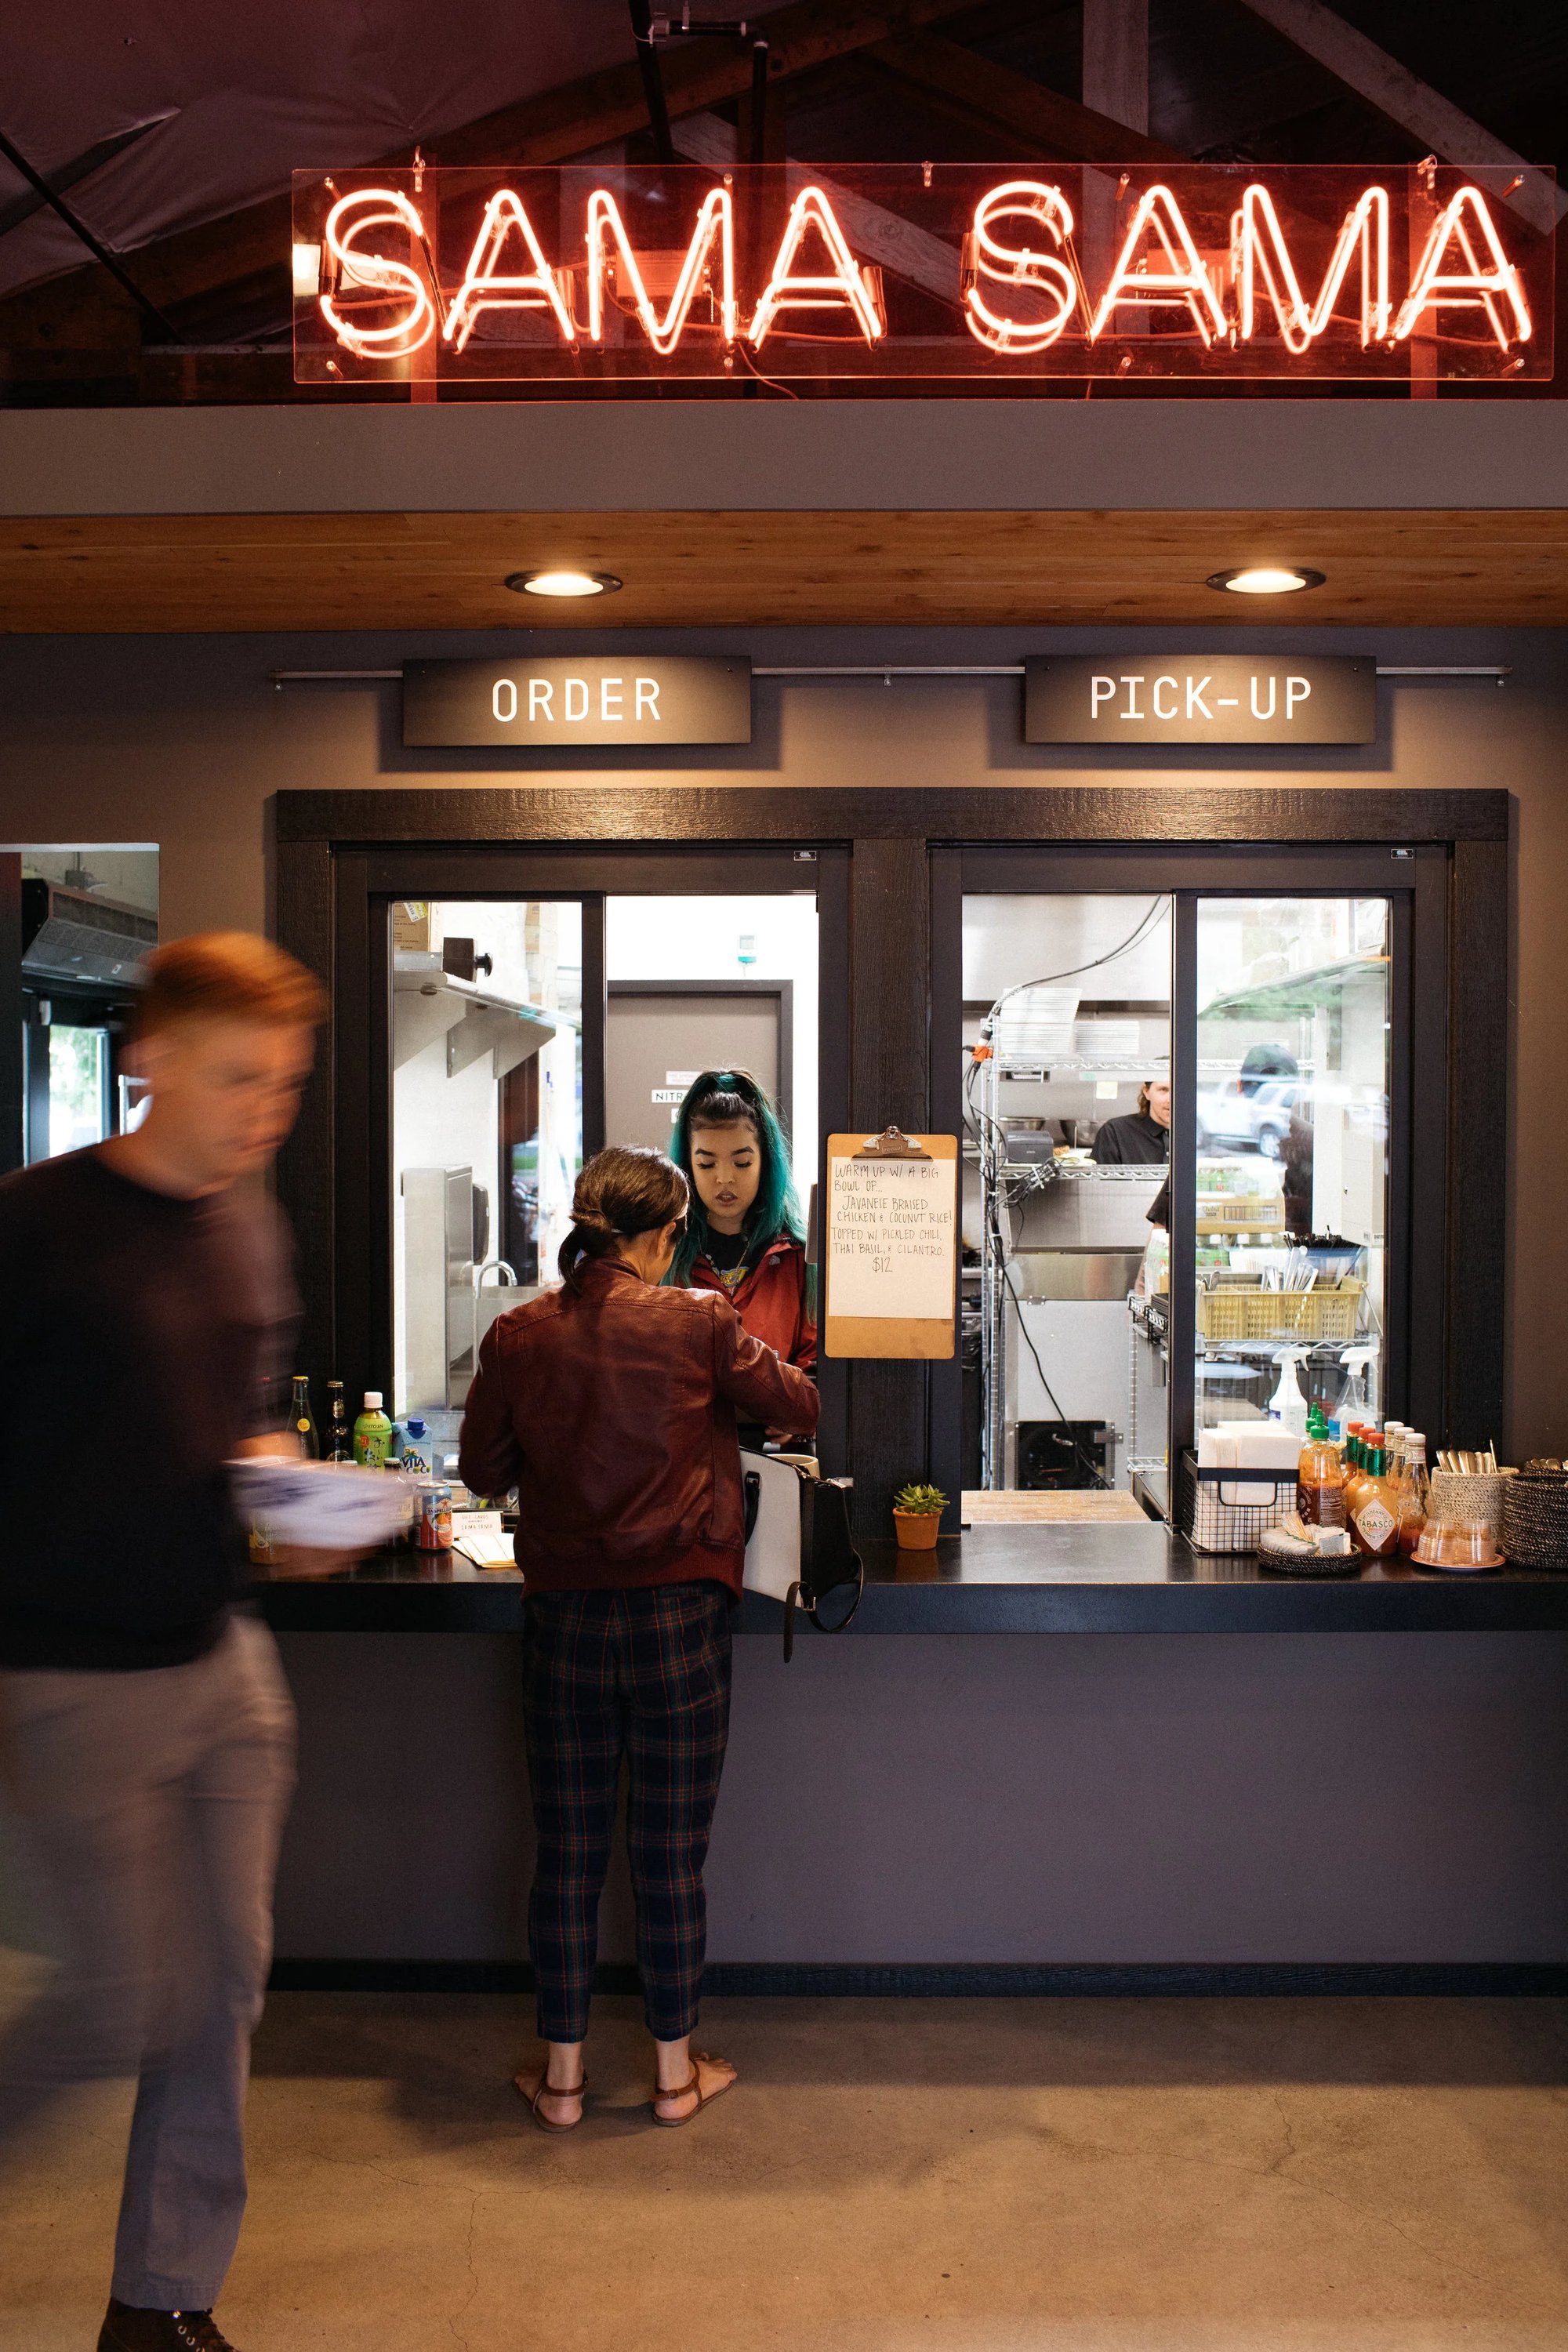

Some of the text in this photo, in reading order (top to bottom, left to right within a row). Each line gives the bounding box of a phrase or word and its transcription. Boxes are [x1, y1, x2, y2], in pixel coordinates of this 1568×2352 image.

[319, 182, 1534, 345] SAMA SAMA
[492, 677, 661, 723] ORDER
[1091, 675, 1312, 720] PICK-UP
[835, 1163, 939, 1178] WARM UP W/ A BIG
[834, 1180, 860, 1191] BOWL
[842, 1195, 929, 1211] JAVANESE BRAISED
[837, 1211, 876, 1223] CHICKEN
[929, 1210, 952, 1226] RICE!
[831, 1227, 864, 1240] TOPPED
[867, 1229, 877, 1241] W/
[882, 1229, 916, 1240] PICKLED
[833, 1243, 855, 1254] THAI
[858, 1243, 886, 1254] BASIL,
[897, 1244, 945, 1256] CILANTRO.
[872, 1256, 894, 1273] $12
[401, 1456, 426, 1468] VITA
[1358, 1519, 1393, 1528] TABASCO
